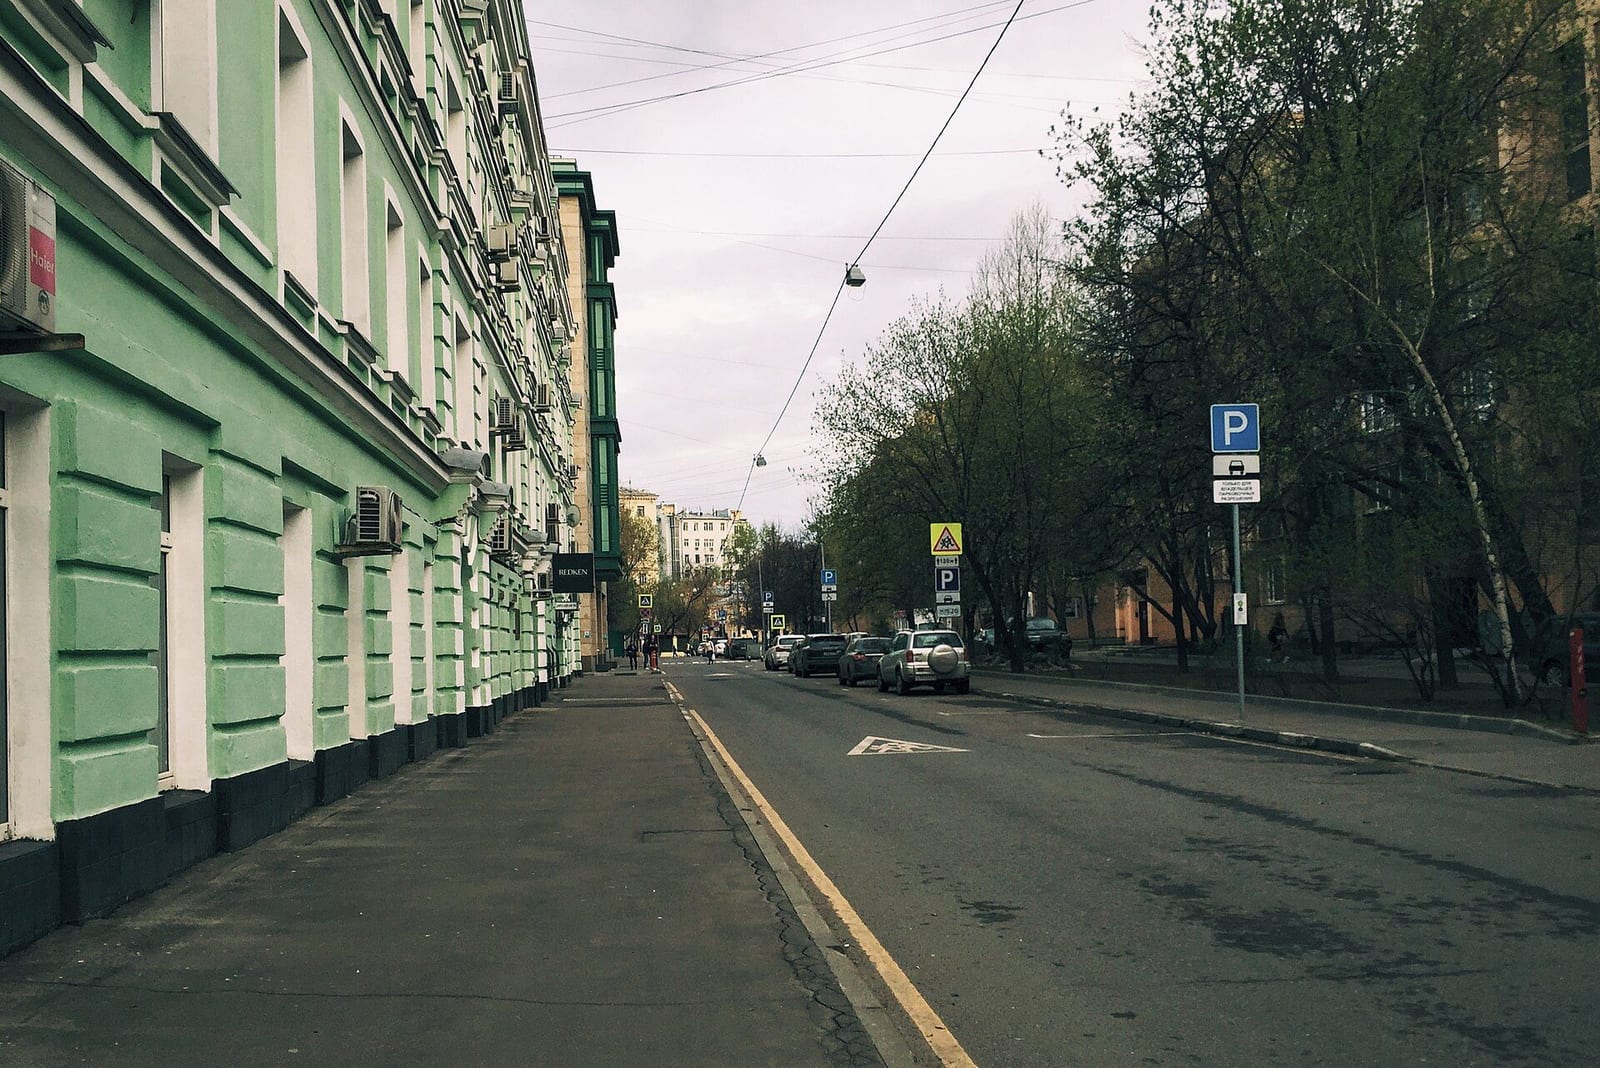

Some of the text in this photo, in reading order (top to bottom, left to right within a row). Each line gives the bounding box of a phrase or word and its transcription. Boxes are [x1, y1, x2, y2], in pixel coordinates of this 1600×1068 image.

[31, 247, 54, 273] Haier
[1223, 410, 1248, 445] P
[558, 568, 588, 576] REDKEN
[825, 571, 833, 583] P
[941, 569, 954, 590] P
[765, 592, 772, 601] P
